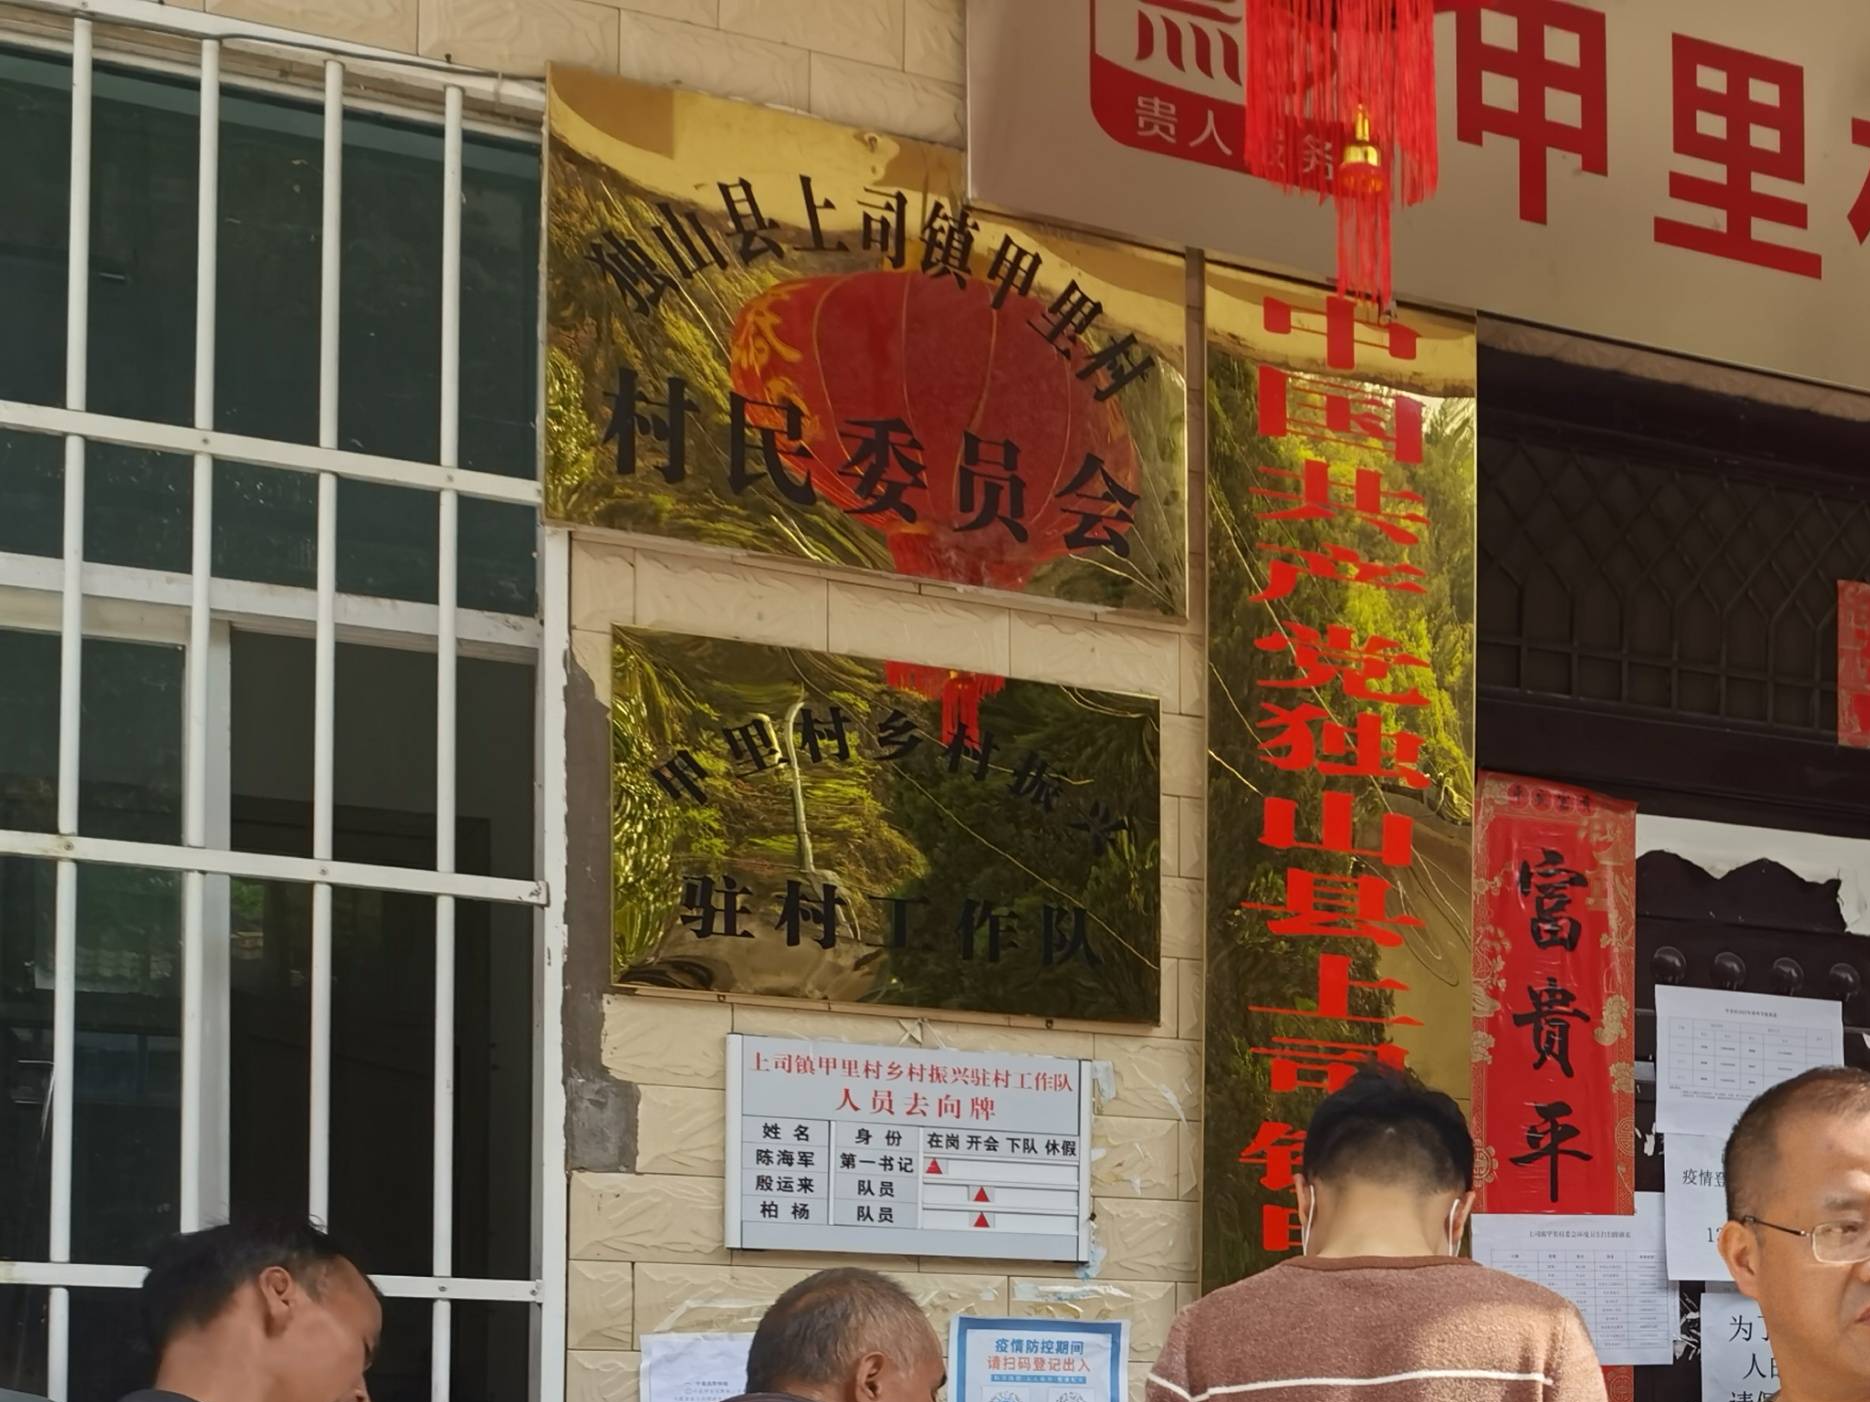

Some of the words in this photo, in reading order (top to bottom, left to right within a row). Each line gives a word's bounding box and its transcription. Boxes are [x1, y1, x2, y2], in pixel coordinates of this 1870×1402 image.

[584, 175, 1156, 403] 独山县上司镇甲里村
[602, 367, 1143, 558] 村民委员会
[651, 706, 1132, 855] 甲里村乡村振兴
[680, 874, 1102, 968] 驻村工作队
[752, 1051, 1074, 1093] 上司镇甲里村乡村振兴驻村工作队
[835, 1087, 996, 1121] 人员去向牌
[762, 1122, 811, 1143] 姓名
[855, 1127, 903, 1147] 身份
[927, 1131, 960, 1151] 在岗
[966, 1134, 1000, 1153] 开会
[1006, 1136, 1039, 1155] 下队
[1045, 1139, 1077, 1158] 休假
[755, 1148, 815, 1168] 陈海军
[839, 1152, 914, 1174] 第一书记
[755, 1174, 815, 1194] 殷运来
[857, 1179, 895, 1198] 队员
[760, 1200, 810, 1221] 柏杨
[856, 1205, 894, 1224] 队员
[987, 1355, 1091, 1372] 请扫码登记出入
[995, 1338, 1085, 1356] 疫情防控期间
